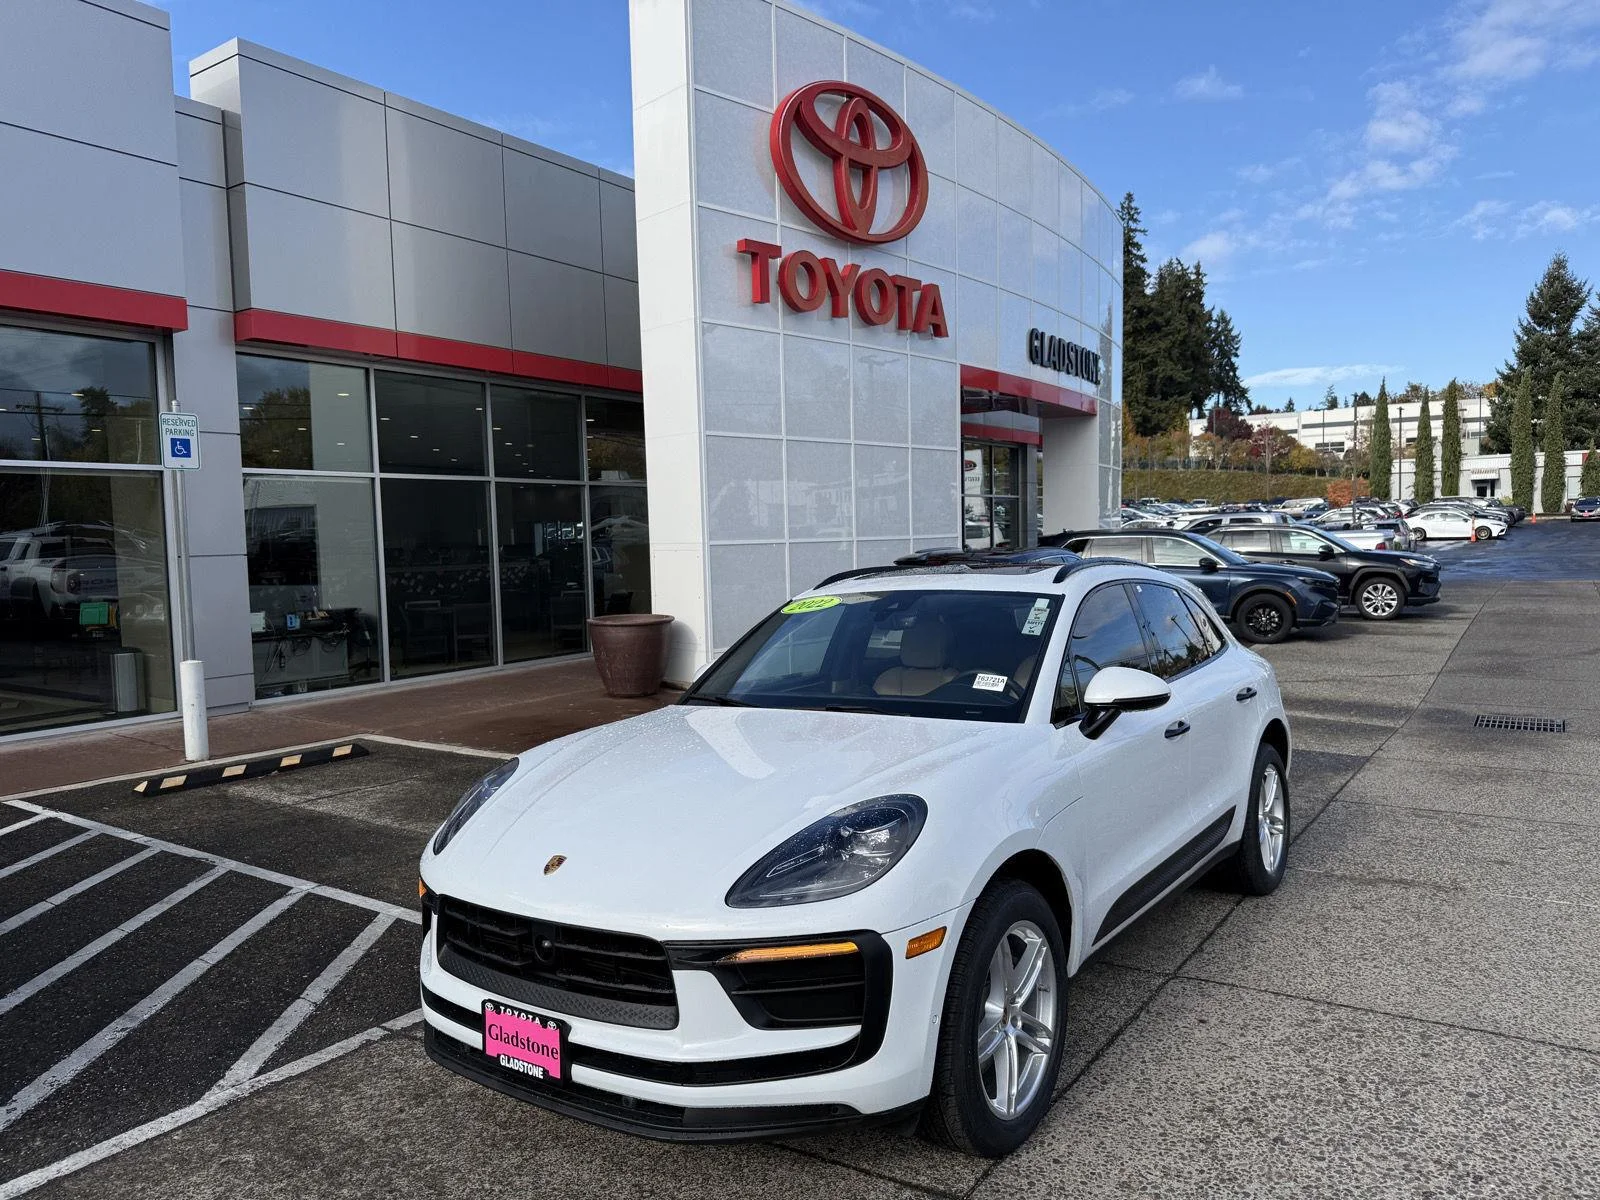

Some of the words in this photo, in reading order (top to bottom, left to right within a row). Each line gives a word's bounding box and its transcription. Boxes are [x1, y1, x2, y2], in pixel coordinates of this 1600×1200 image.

[737, 238, 949, 338] TOYOTA
[1028, 327, 1101, 386] GLADSTONE
[162, 418, 196, 428] RESERVED
[165, 428, 195, 436] PARKING
[500, 1005, 541, 1026] TOYOTA
[488, 1023, 559, 1060] Gladstone
[500, 1054, 544, 1079] GLADSTONE
